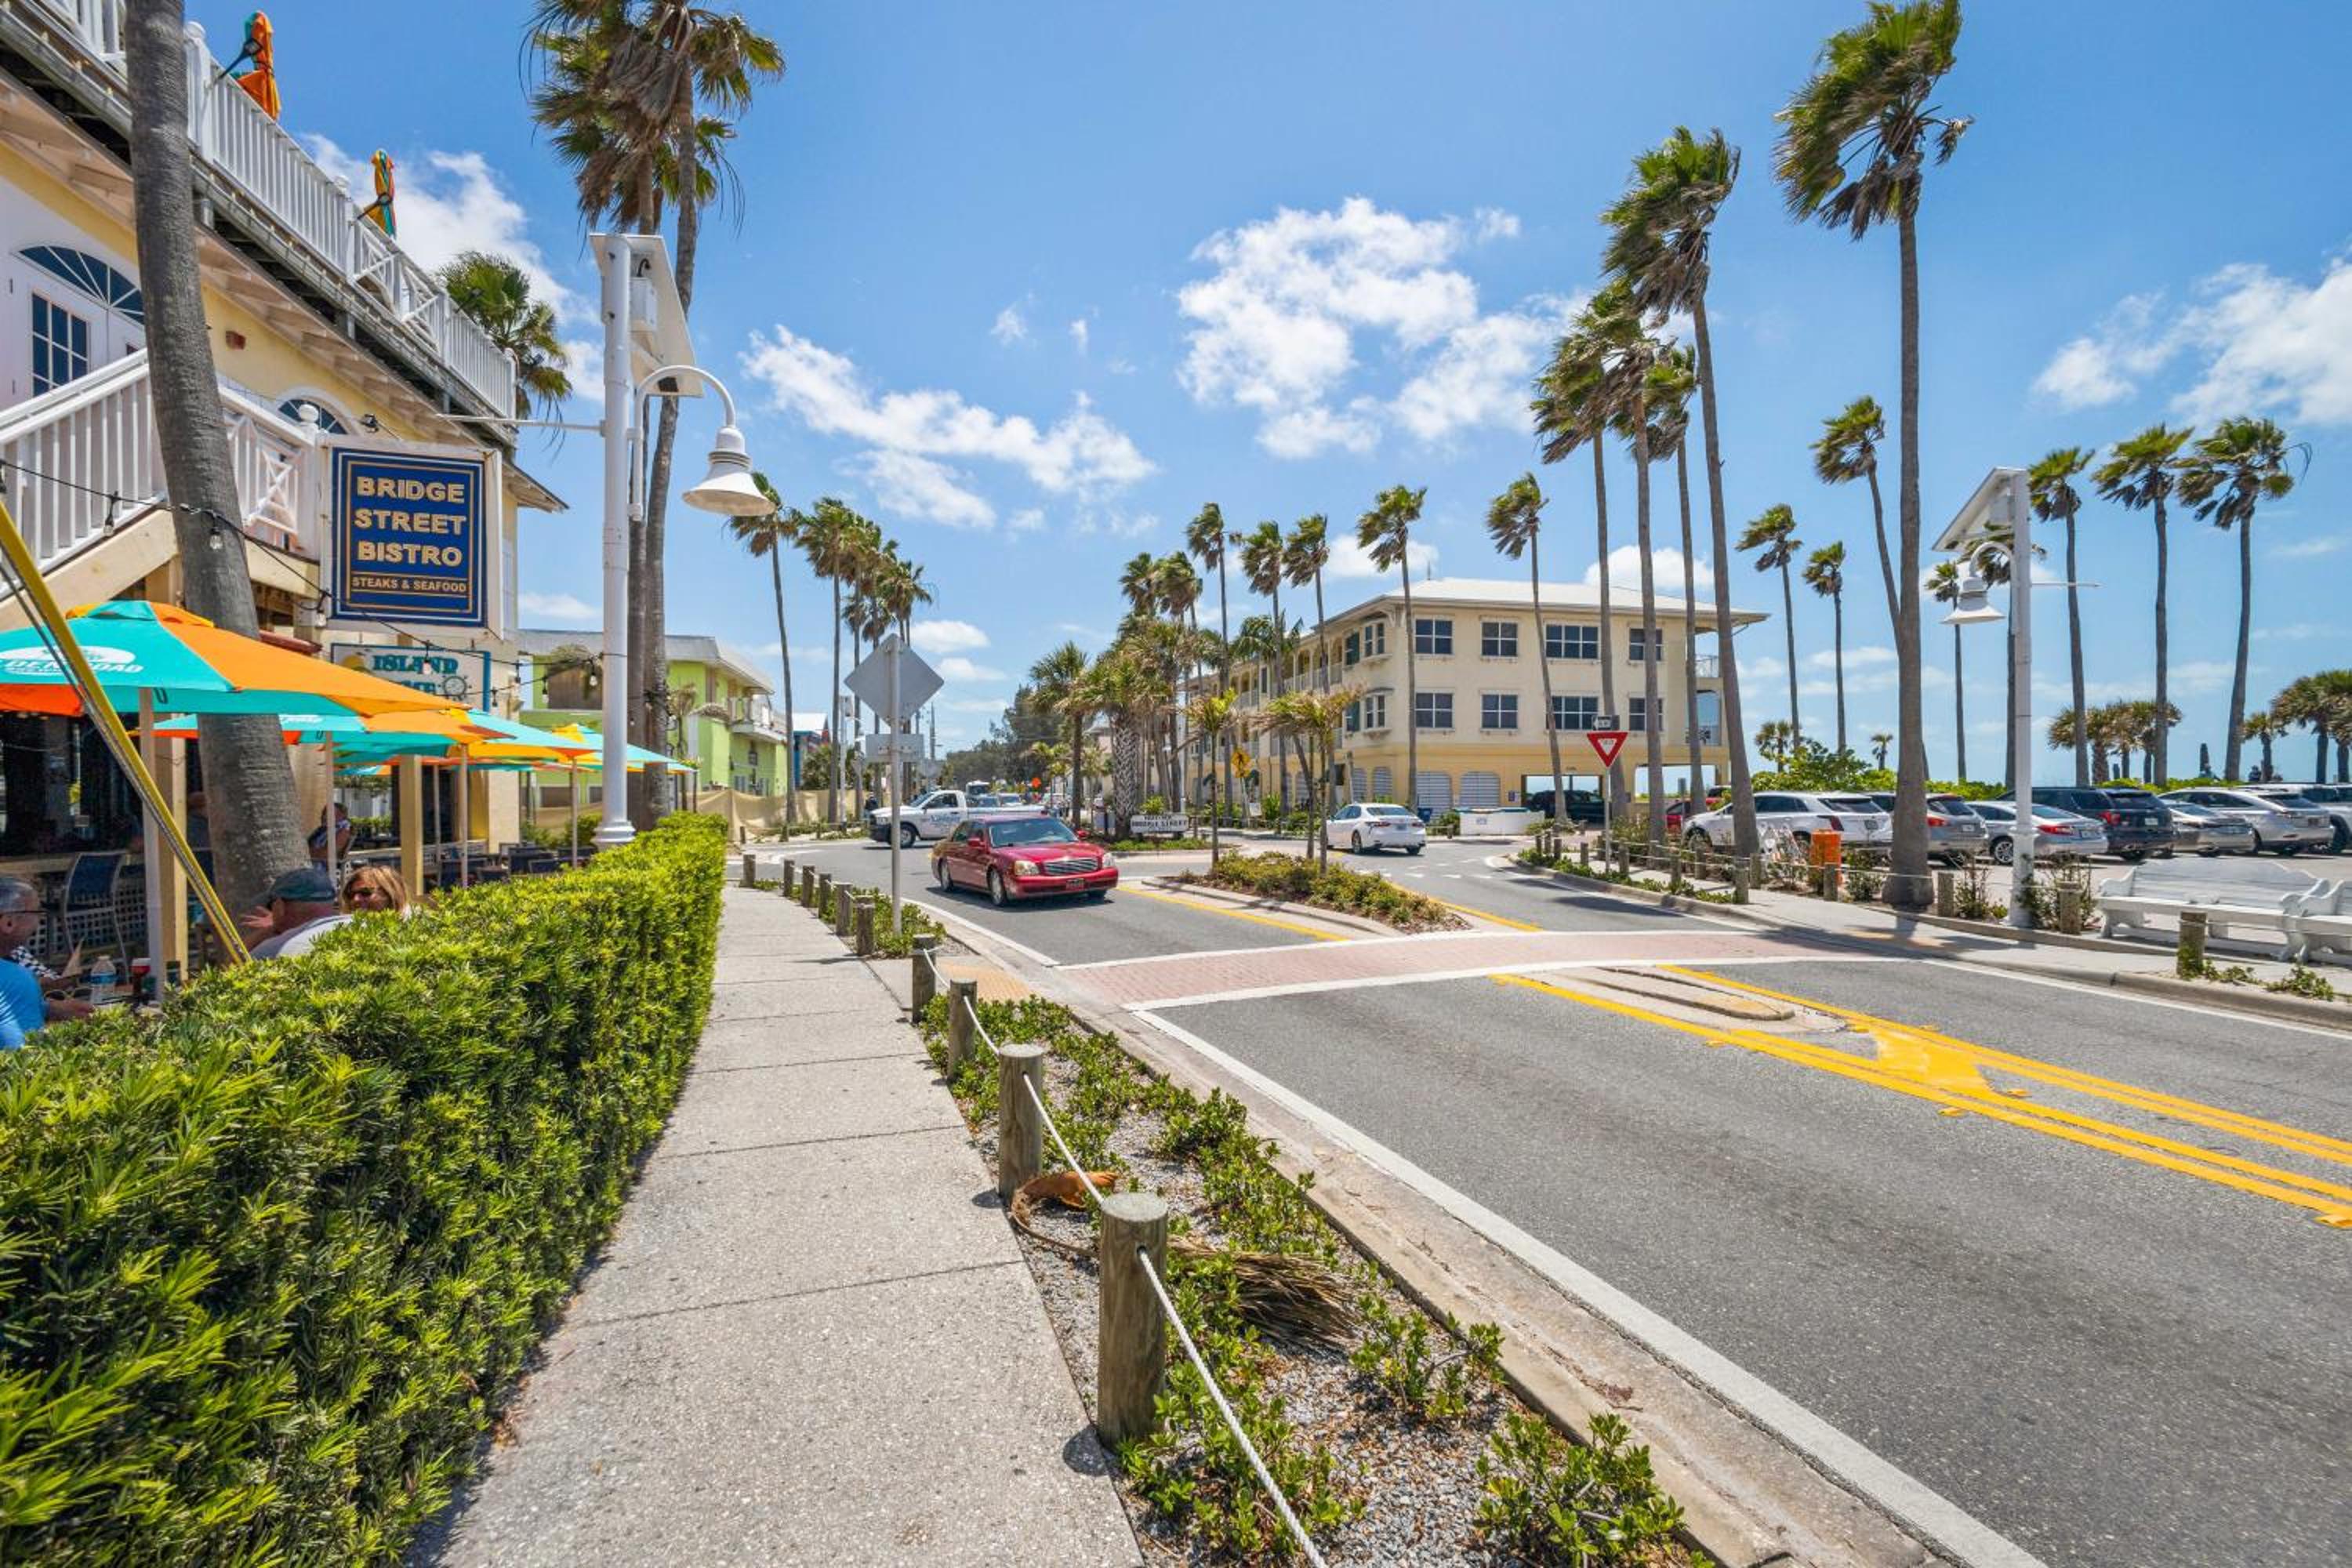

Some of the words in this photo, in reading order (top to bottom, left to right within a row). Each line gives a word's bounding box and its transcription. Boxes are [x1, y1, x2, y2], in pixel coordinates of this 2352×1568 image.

[357, 476, 465, 504] BRIDGE
[354, 508, 467, 535] STREET
[358, 540, 463, 567] BISTRO
[353, 576, 397, 589] STEAKS
[401, 579, 410, 590] &
[413, 581, 466, 593] SEAFOOD
[372, 655, 459, 674] ISLAND
